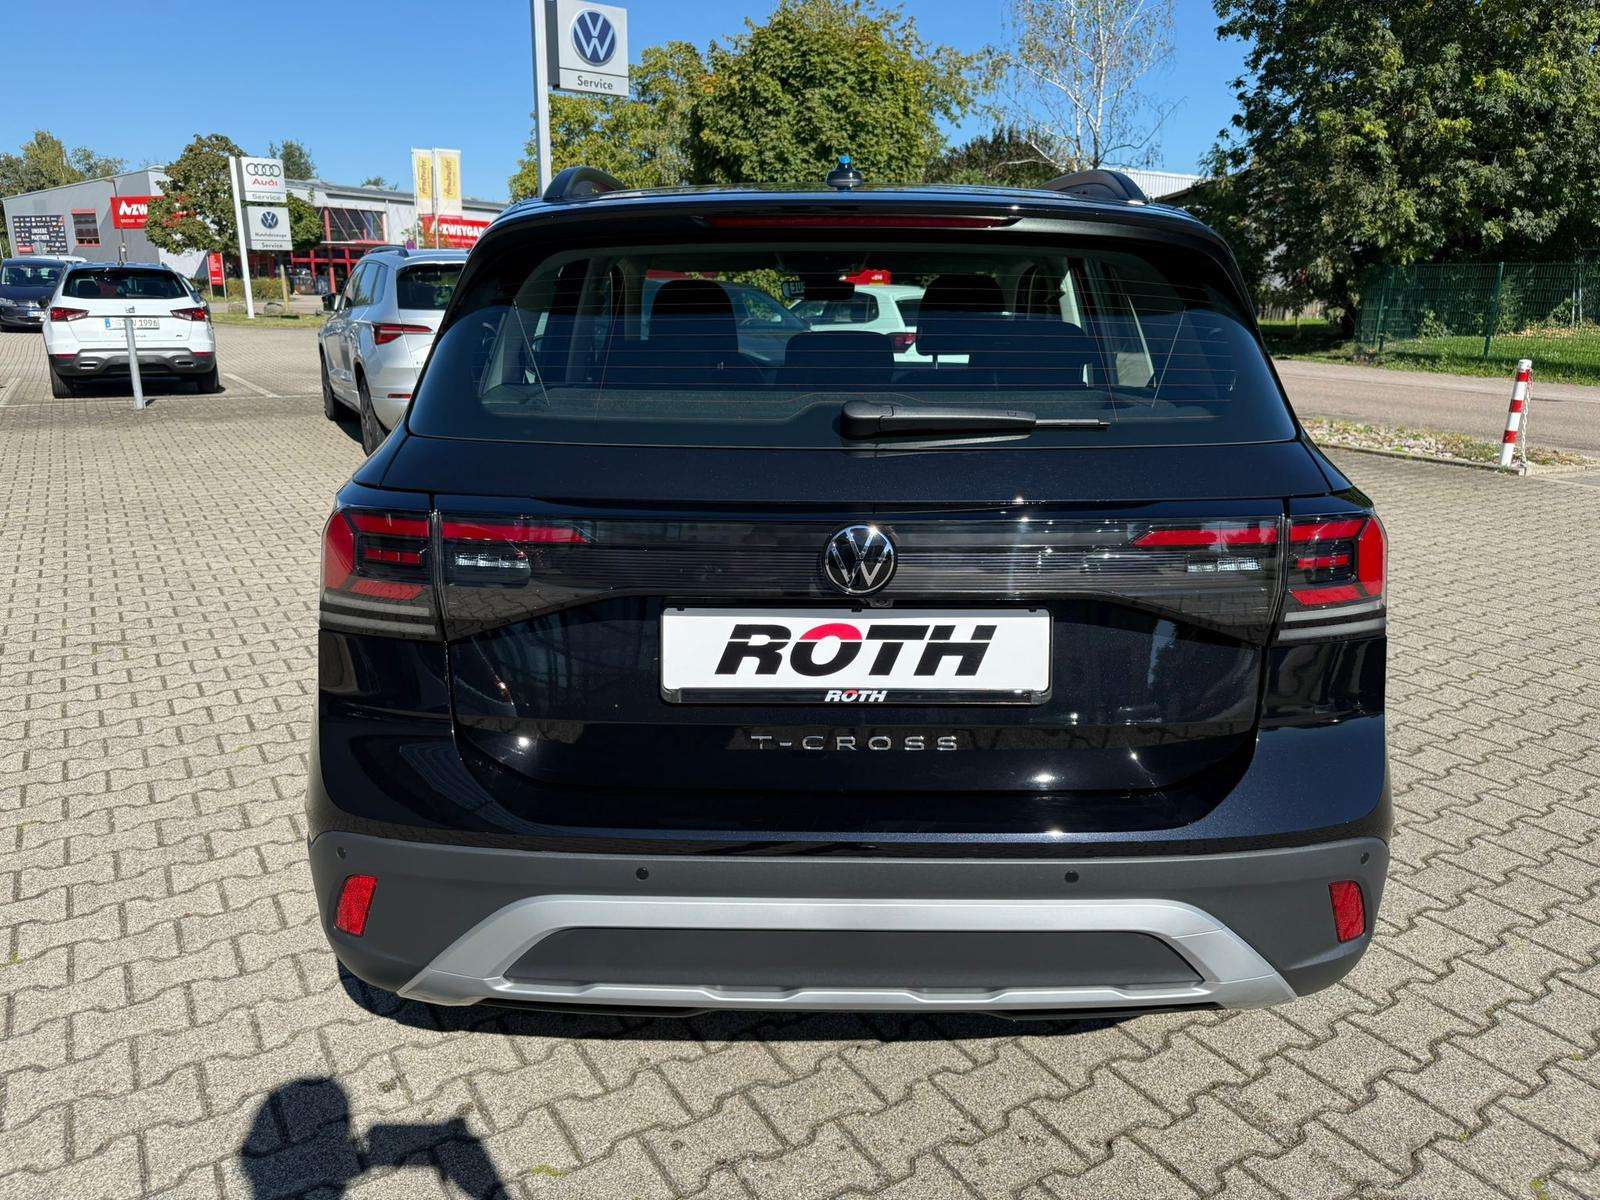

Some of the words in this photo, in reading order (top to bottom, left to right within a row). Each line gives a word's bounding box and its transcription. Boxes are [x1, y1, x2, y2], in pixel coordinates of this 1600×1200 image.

[577, 75, 614, 90] Service
[252, 178, 278, 187] Audi
[252, 193, 281, 201] Service
[261, 241, 283, 249] Service
[714, 622, 998, 677] ROTH
[824, 688, 888, 703] ROTH
[750, 735, 958, 751] T-CROSS
